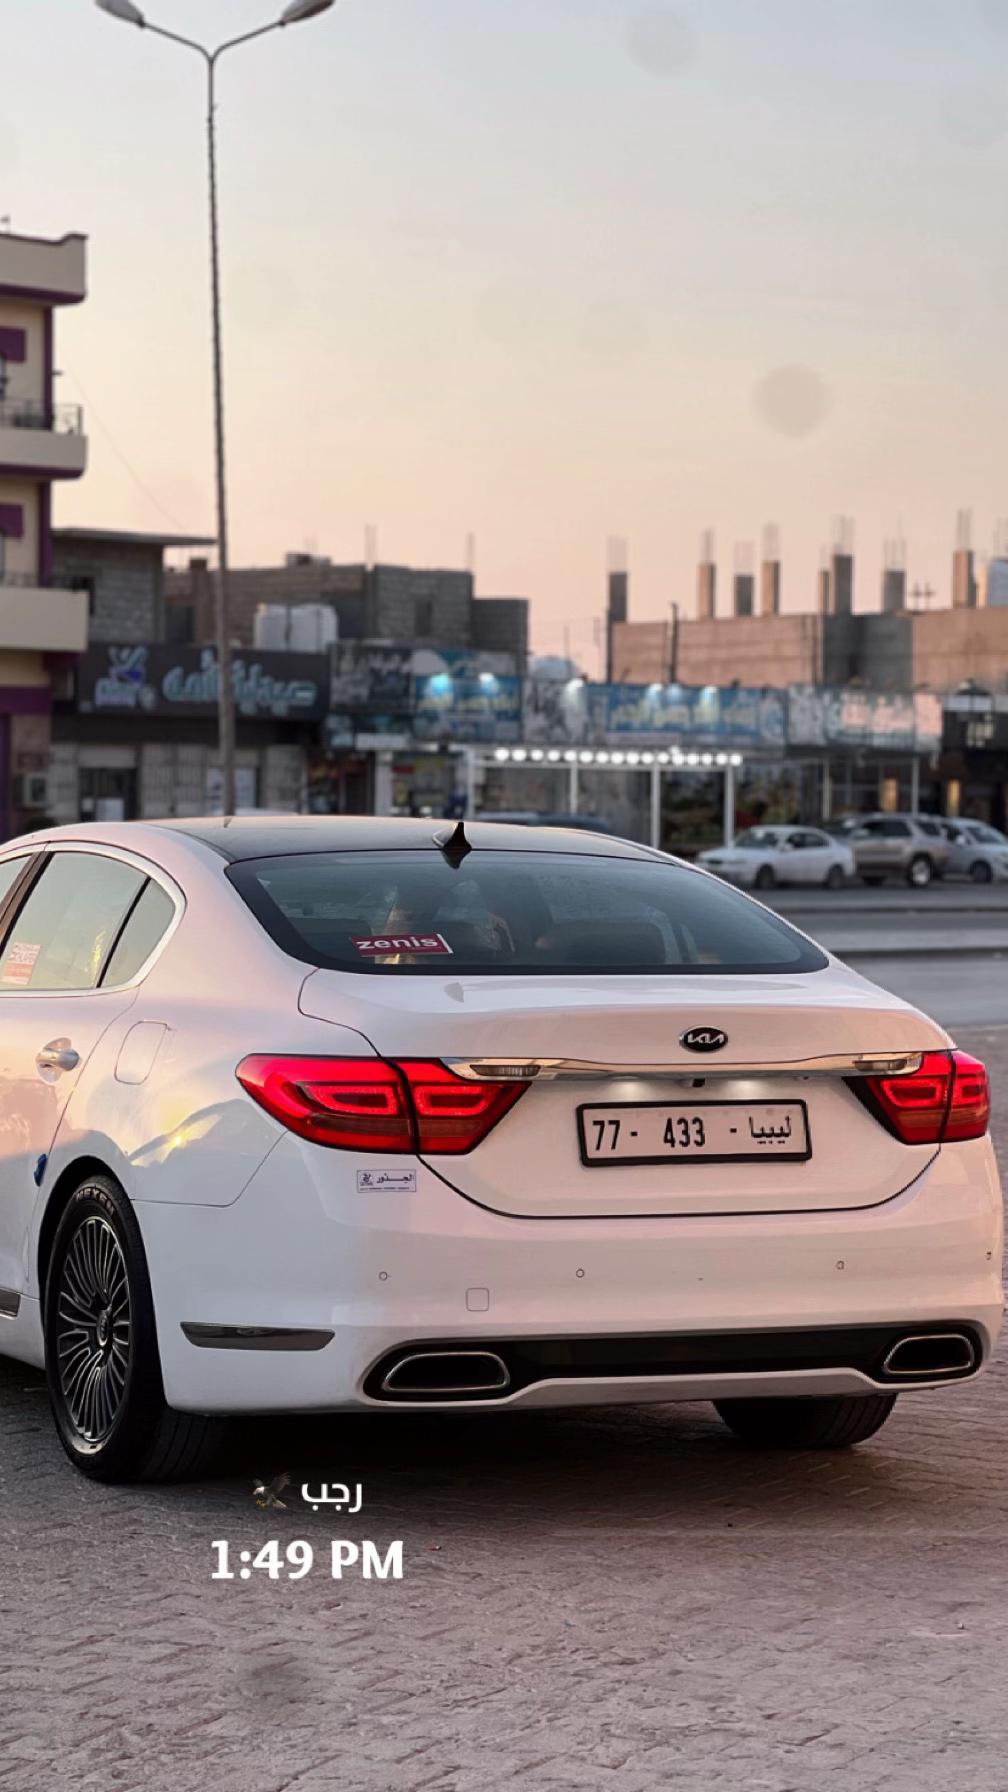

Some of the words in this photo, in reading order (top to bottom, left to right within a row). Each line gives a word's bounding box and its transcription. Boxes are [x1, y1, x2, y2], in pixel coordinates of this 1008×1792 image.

[356, 936, 438, 949] zenis
[593, 1120, 621, 1152] 77
[663, 1116, 706, 1148] 433
[748, 1115, 792, 1145] ليبيا
